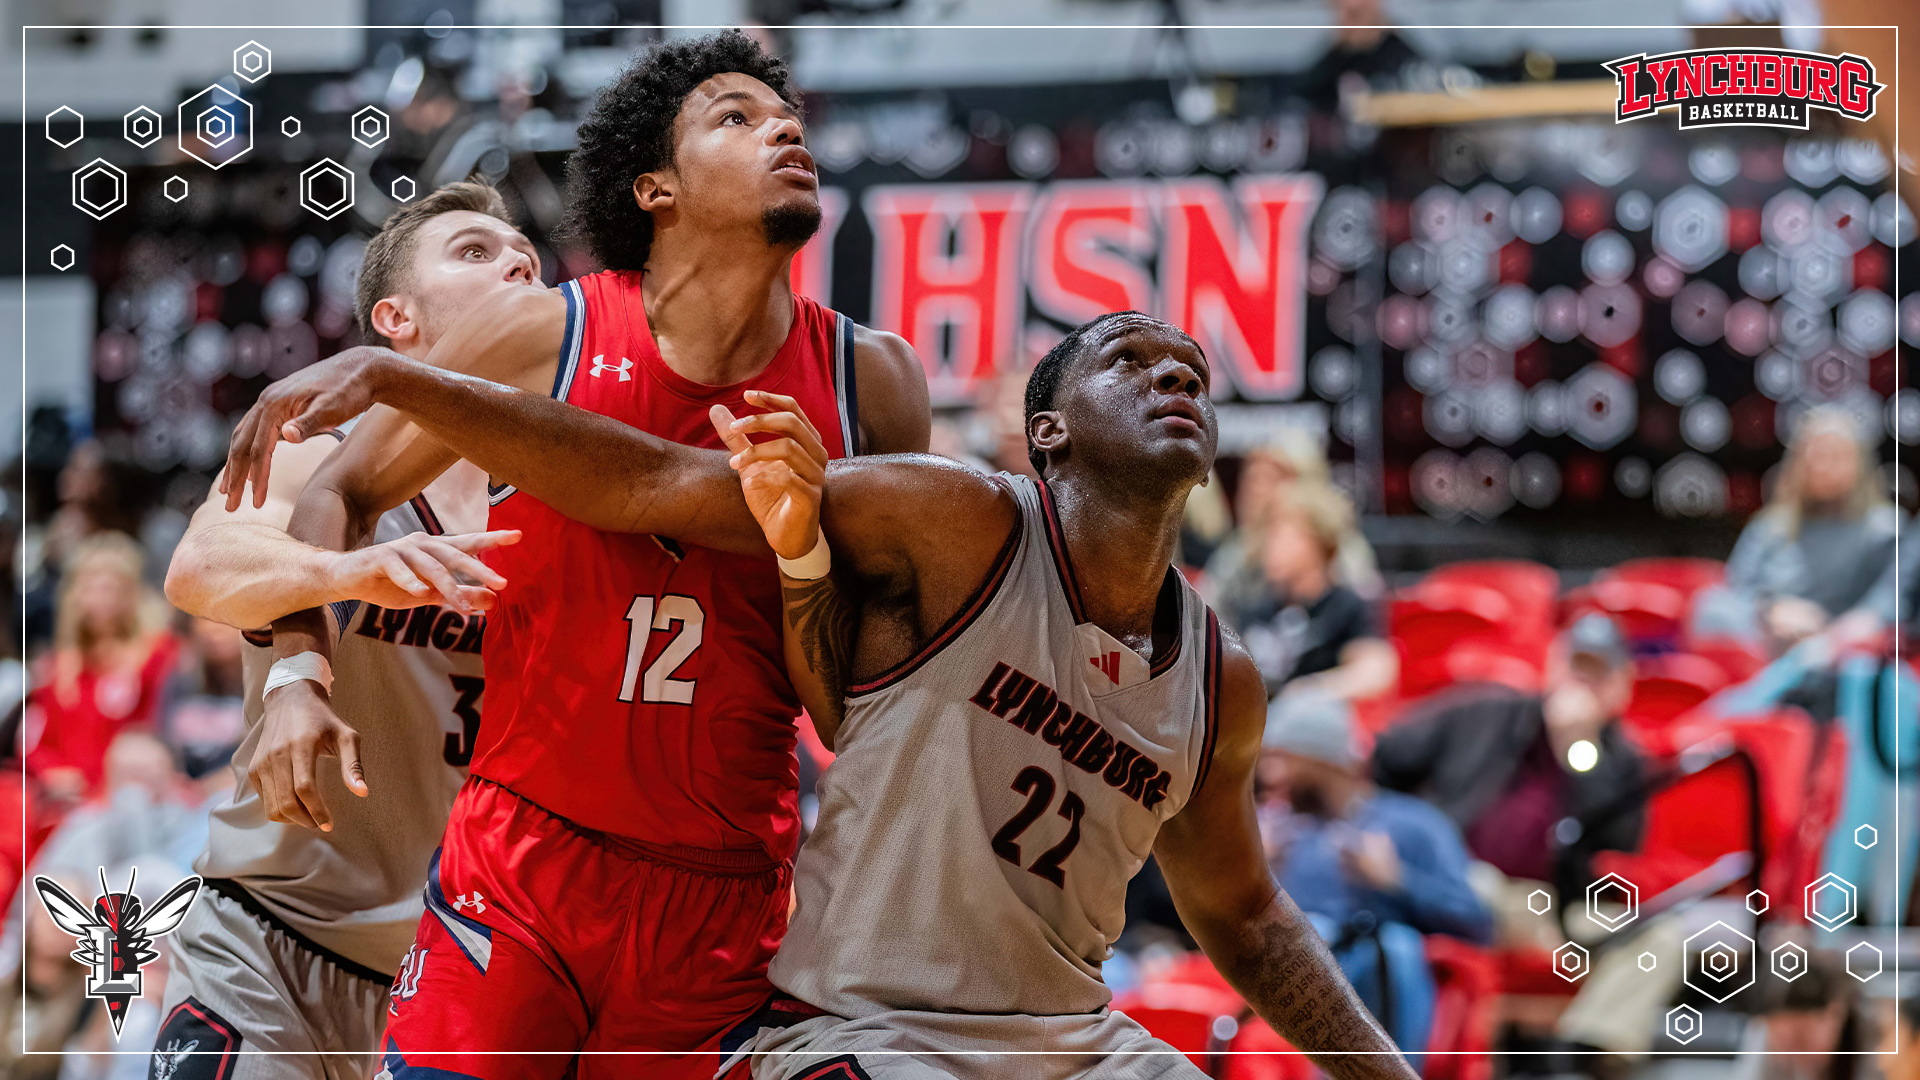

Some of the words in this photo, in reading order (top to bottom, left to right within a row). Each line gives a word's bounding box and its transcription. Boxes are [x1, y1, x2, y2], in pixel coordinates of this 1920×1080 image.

[790, 173, 1325, 403] HSN
[616, 593, 706, 705] 12
[443, 673, 485, 767] 3
[969, 661, 1172, 812] LYNCHBURG
[991, 765, 1085, 890] 22
